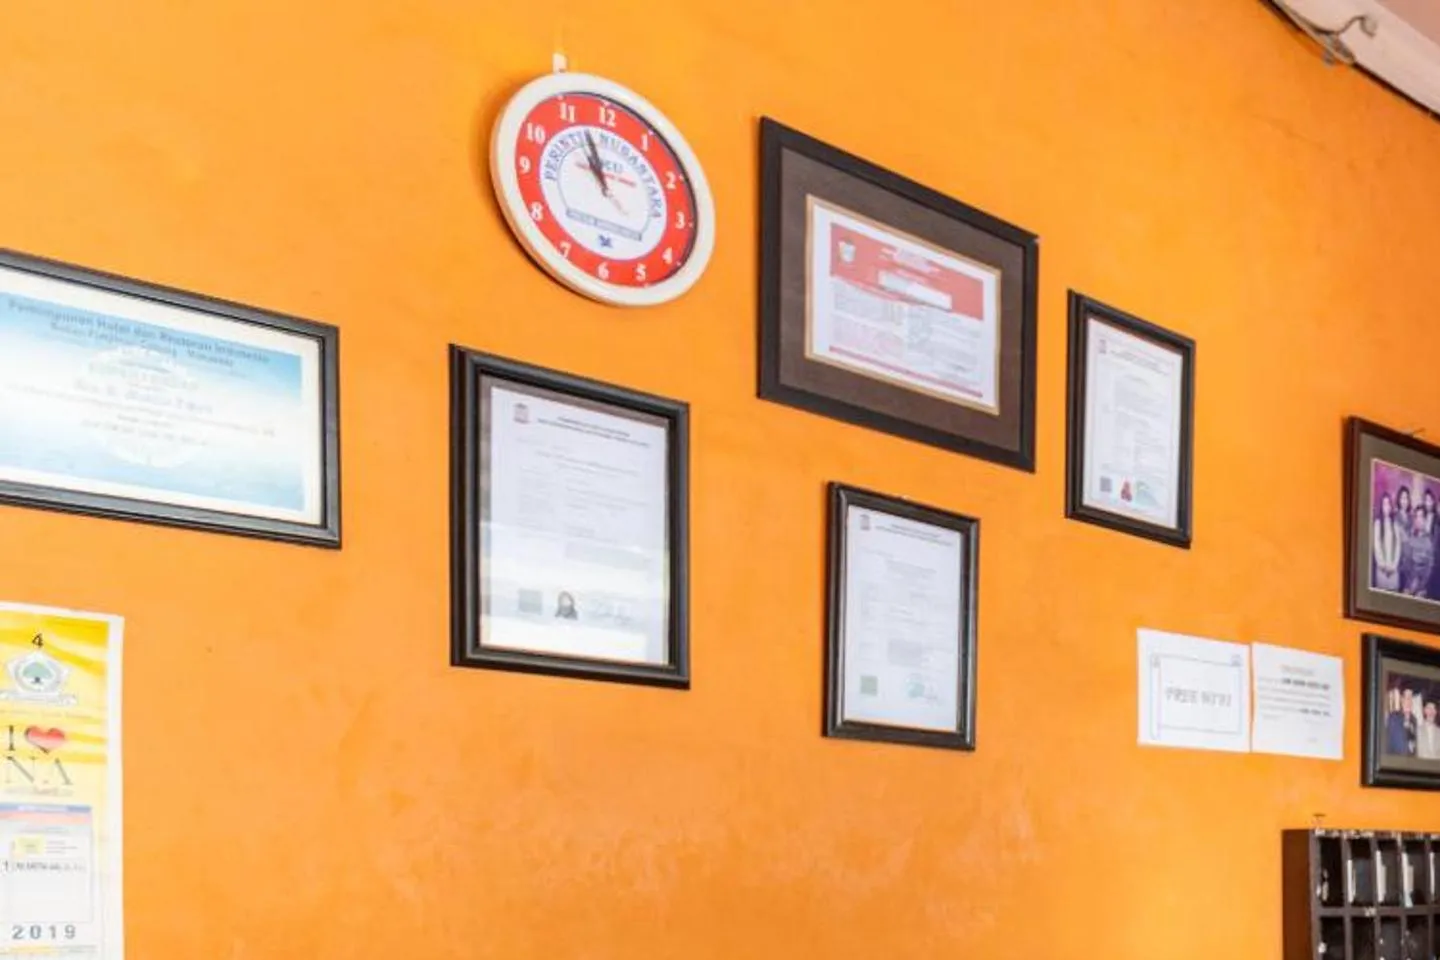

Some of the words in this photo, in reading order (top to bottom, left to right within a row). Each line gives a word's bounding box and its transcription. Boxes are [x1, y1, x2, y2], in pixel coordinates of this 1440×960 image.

[558, 103, 576, 123] 11
[600, 107, 616, 128] 12
[526, 122, 546, 144] 10
[641, 134, 649, 151] 1
[520, 156, 531, 173] 9
[665, 170, 677, 189] 2
[530, 201, 544, 221] 8
[675, 211, 686, 229] 3
[558, 242, 571, 259] 7
[662, 247, 673, 263] 4
[597, 264, 609, 279] 6
[635, 263, 647, 281] 5
[11, 924, 77, 941] 2019
